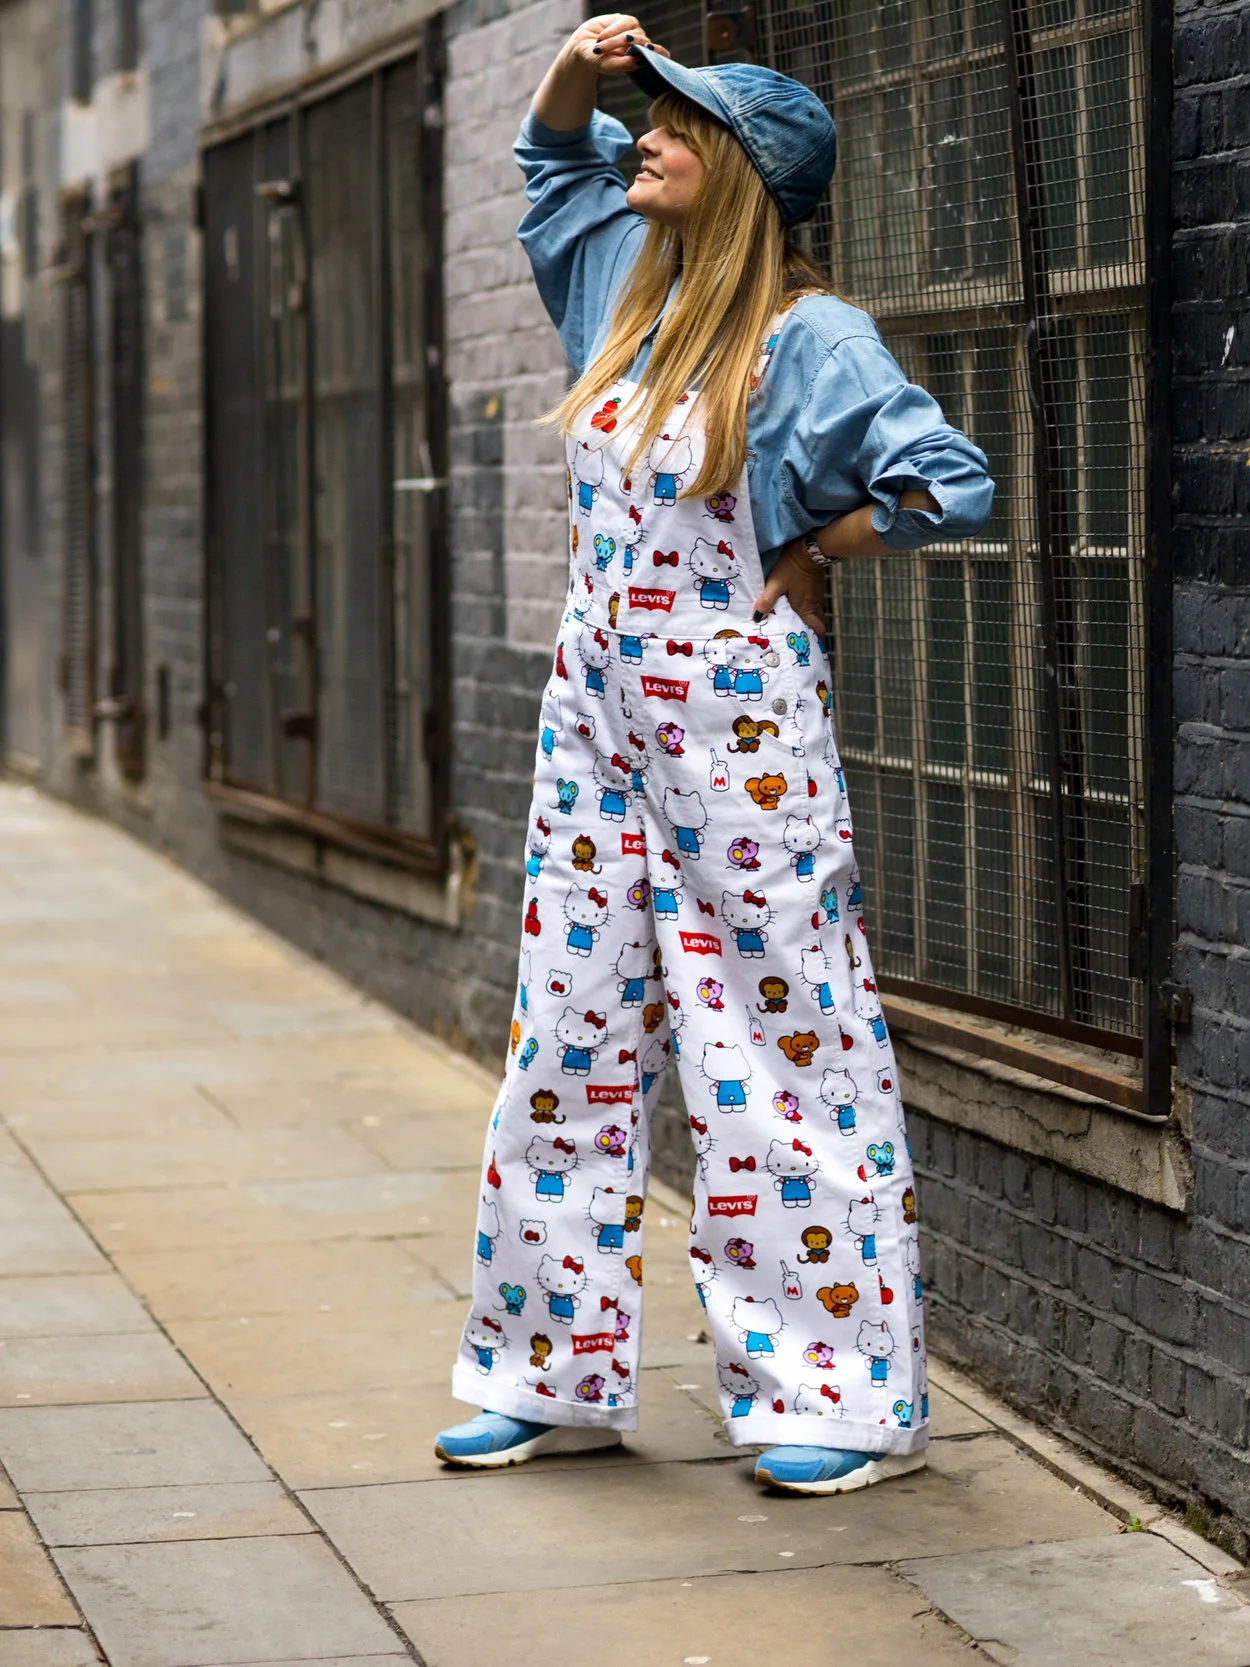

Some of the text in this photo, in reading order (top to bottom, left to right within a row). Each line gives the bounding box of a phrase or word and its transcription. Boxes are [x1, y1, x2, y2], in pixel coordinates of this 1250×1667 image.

[713, 777, 726, 787] M
[753, 1031, 763, 1042] M
[787, 1286, 799, 1296] M
